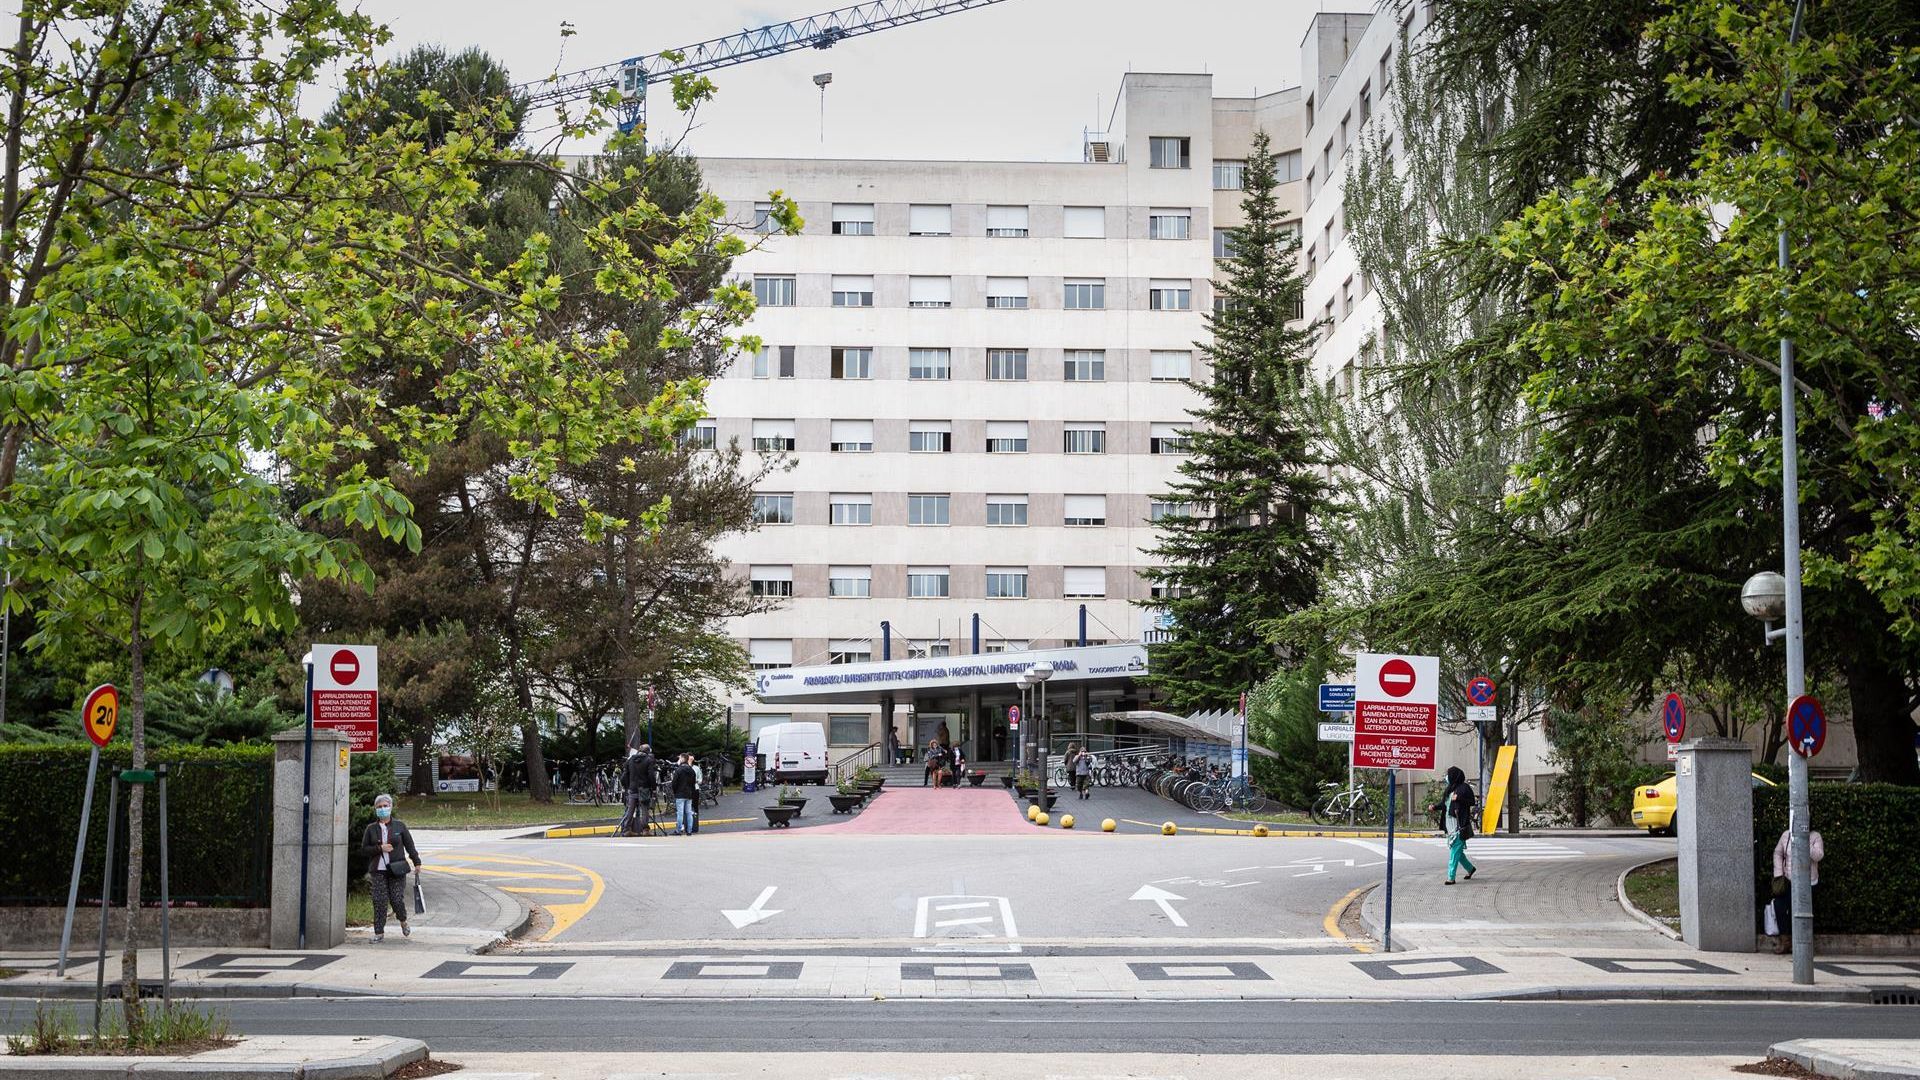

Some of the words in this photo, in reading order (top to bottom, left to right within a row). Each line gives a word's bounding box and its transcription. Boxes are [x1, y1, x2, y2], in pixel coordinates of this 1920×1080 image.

[1363, 704, 1419, 713] LARRIALDIETARAKO
[96, 705, 113, 727] 20
[1389, 712, 1430, 720] DUTENENTZAT
[1392, 718, 1428, 726] PAZIENTEAK
[1401, 725, 1428, 733] BATZEKO
[1359, 743, 1386, 751] LLEGADA
[1360, 750, 1392, 758] PACIENTES
[1376, 758, 1417, 766] AUTORIZADOS
